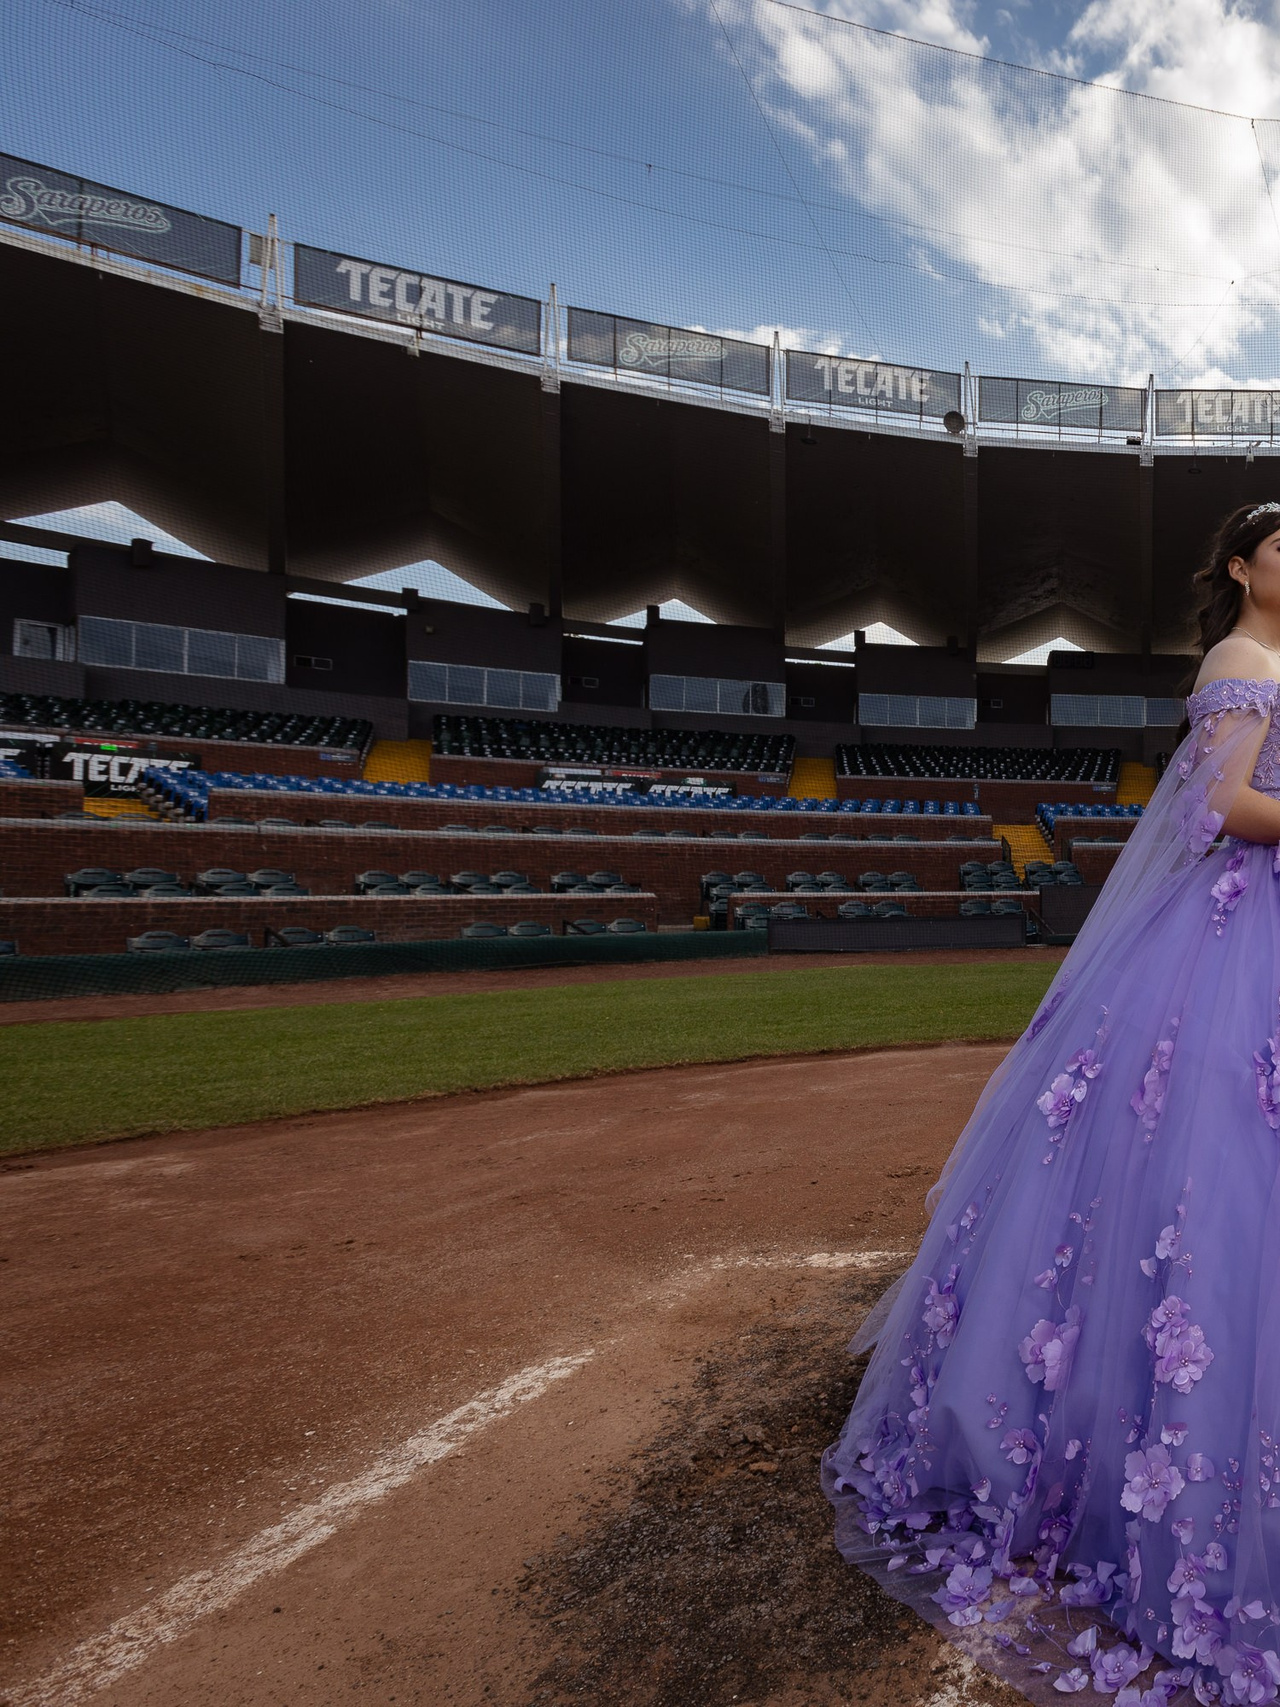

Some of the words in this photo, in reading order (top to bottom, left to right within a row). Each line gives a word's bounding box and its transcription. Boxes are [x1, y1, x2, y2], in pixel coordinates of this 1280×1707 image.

[0, 176, 171, 233] Saraperos
[336, 259, 499, 331] TECATE
[813, 357, 932, 403] TECATE
[857, 397, 894, 409] LIGHT
[1021, 388, 1109, 421] Saraperos
